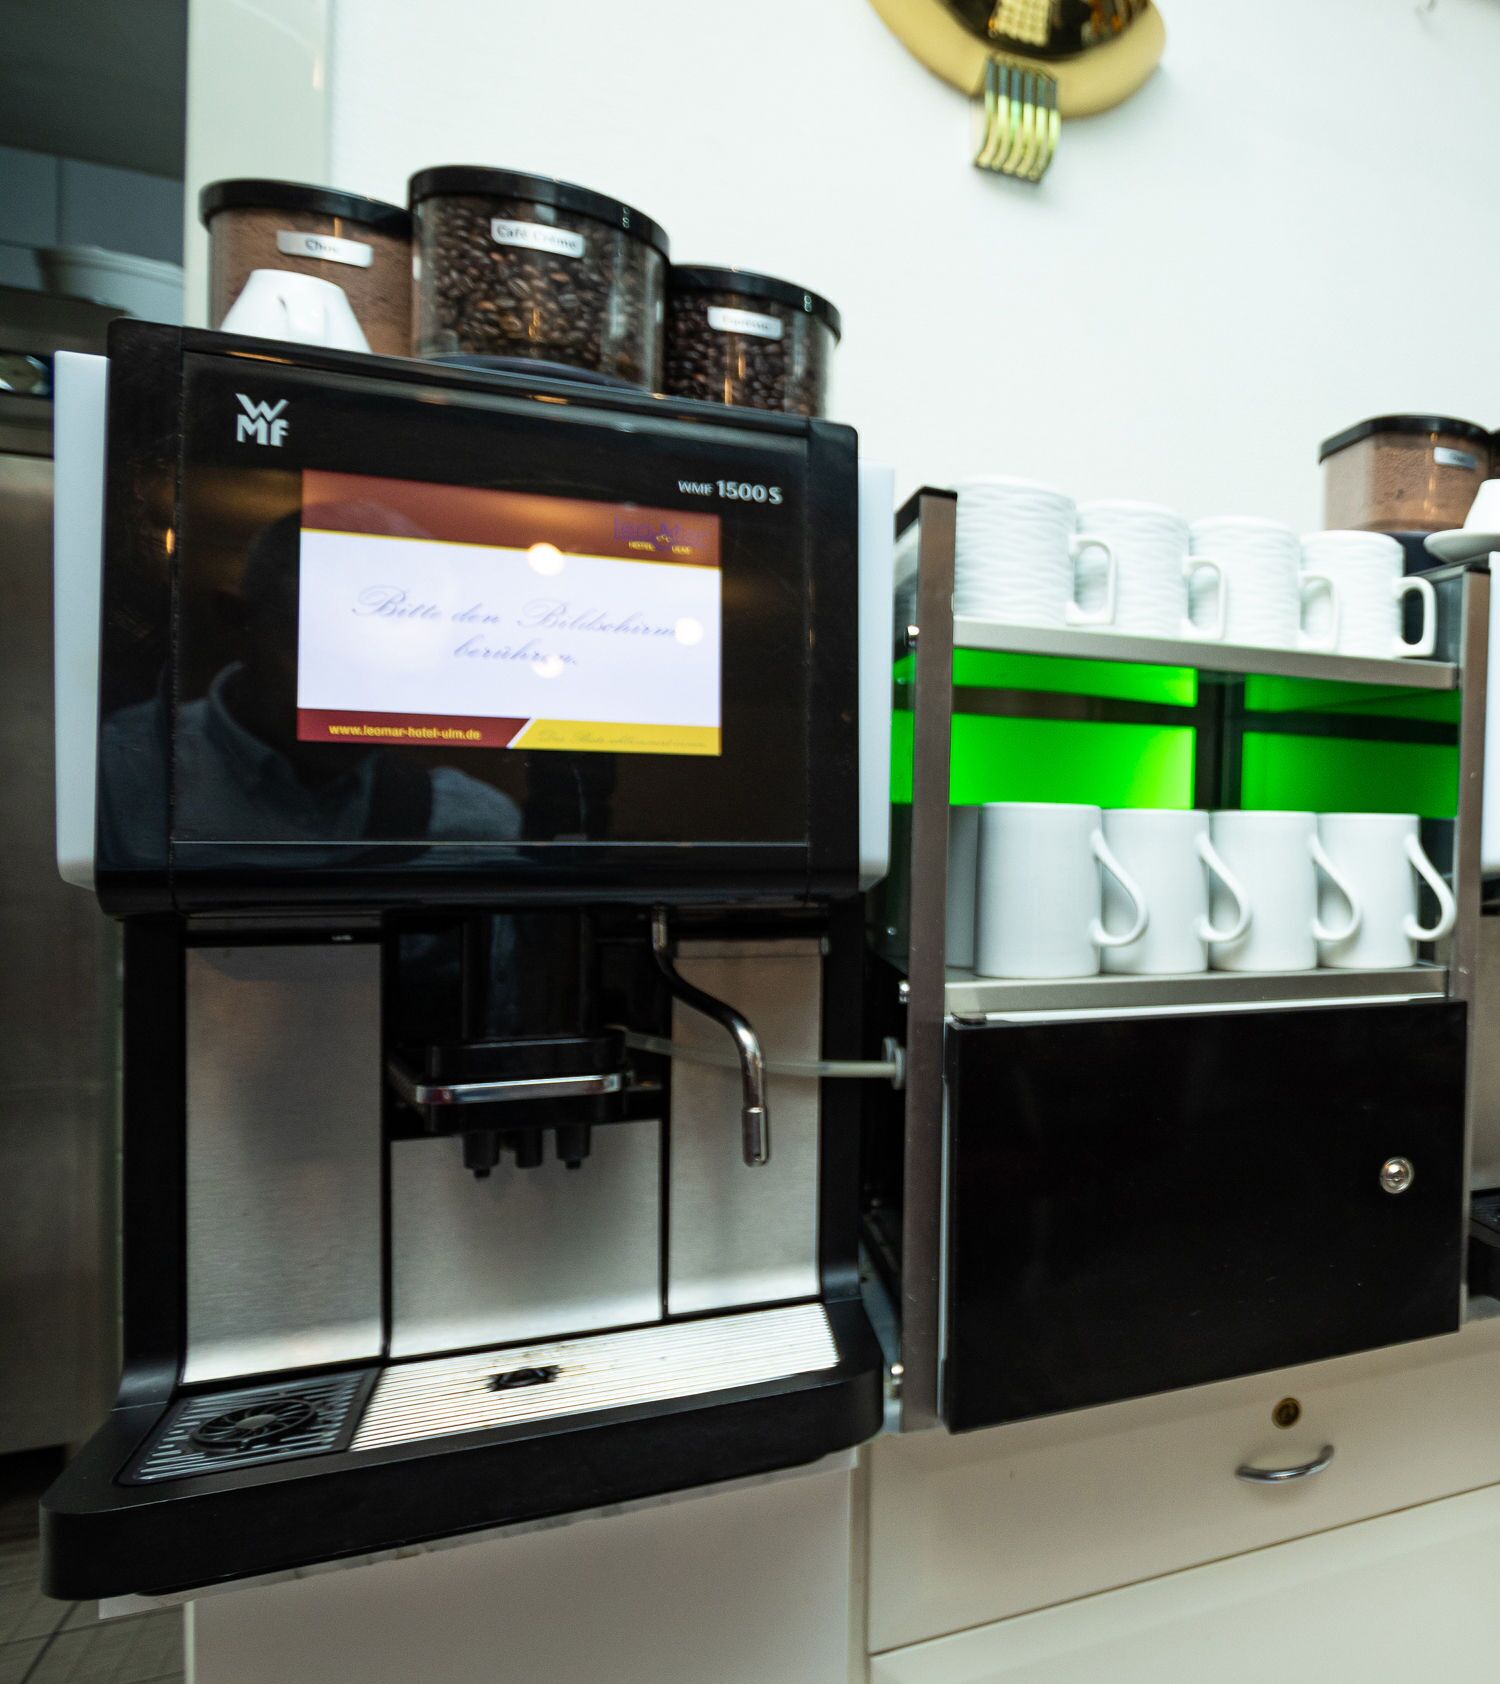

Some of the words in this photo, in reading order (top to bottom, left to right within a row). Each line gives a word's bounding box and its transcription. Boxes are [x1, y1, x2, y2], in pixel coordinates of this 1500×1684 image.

[678, 480, 714, 497] WMF
[352, 584, 442, 619] Bitte
[450, 602, 502, 625] den
[328, 724, 482, 741] www.leomar-hotel-ulm.de
